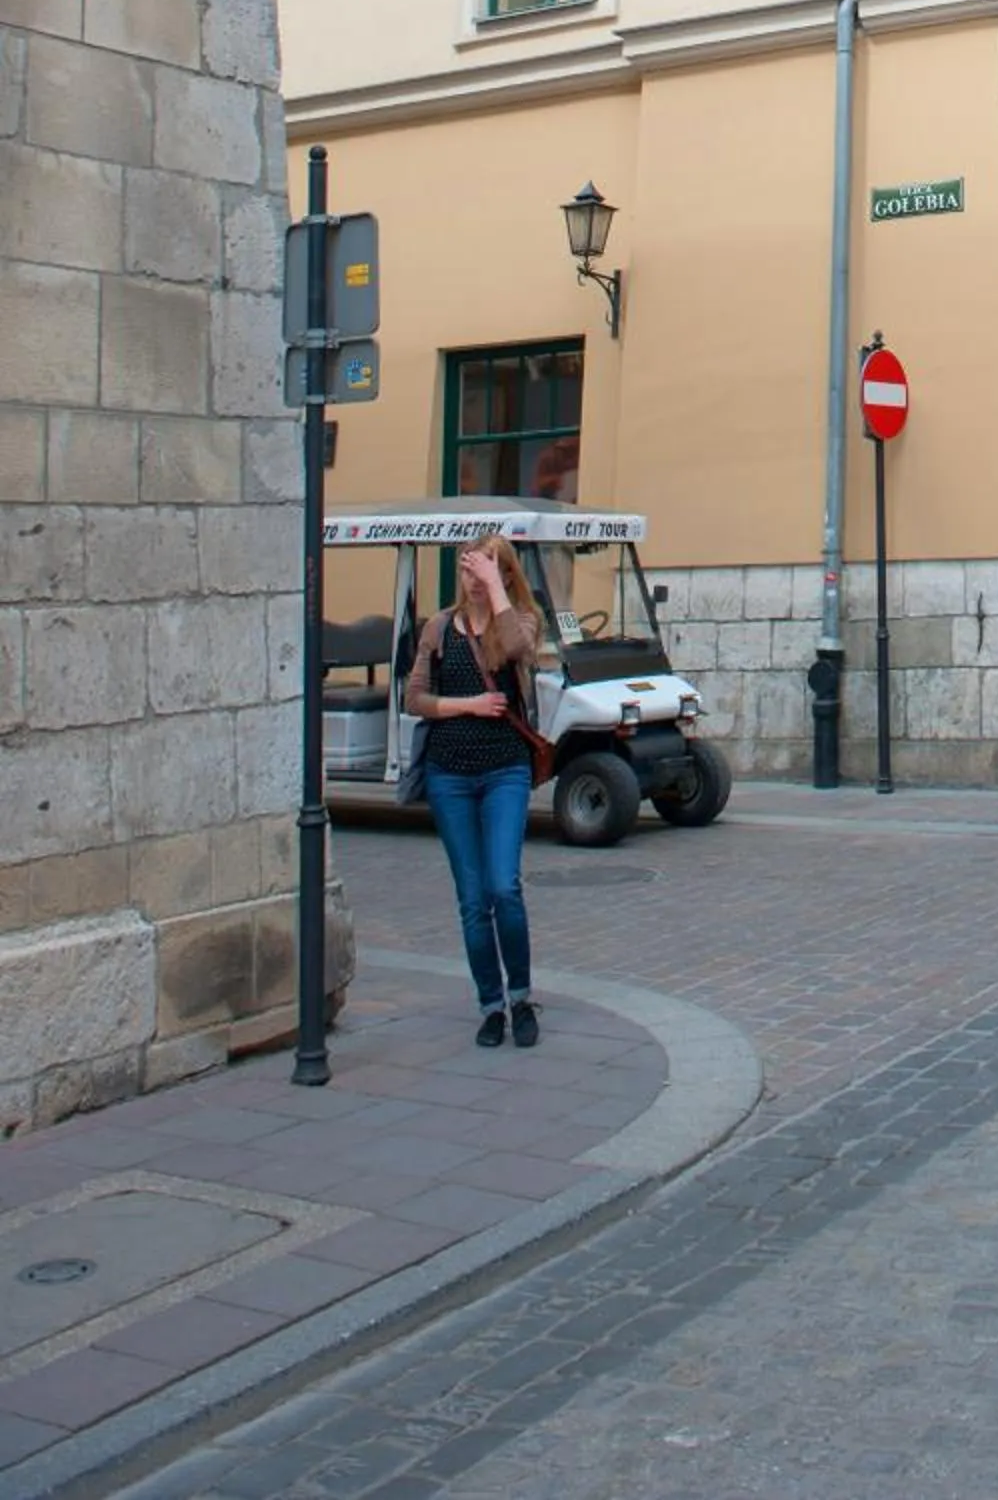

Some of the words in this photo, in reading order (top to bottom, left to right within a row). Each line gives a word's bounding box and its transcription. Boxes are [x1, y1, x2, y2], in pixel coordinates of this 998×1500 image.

[365, 523, 445, 539] SCHINDLERS
[565, 520, 591, 537] CITY
[599, 521, 629, 538] TOUR
